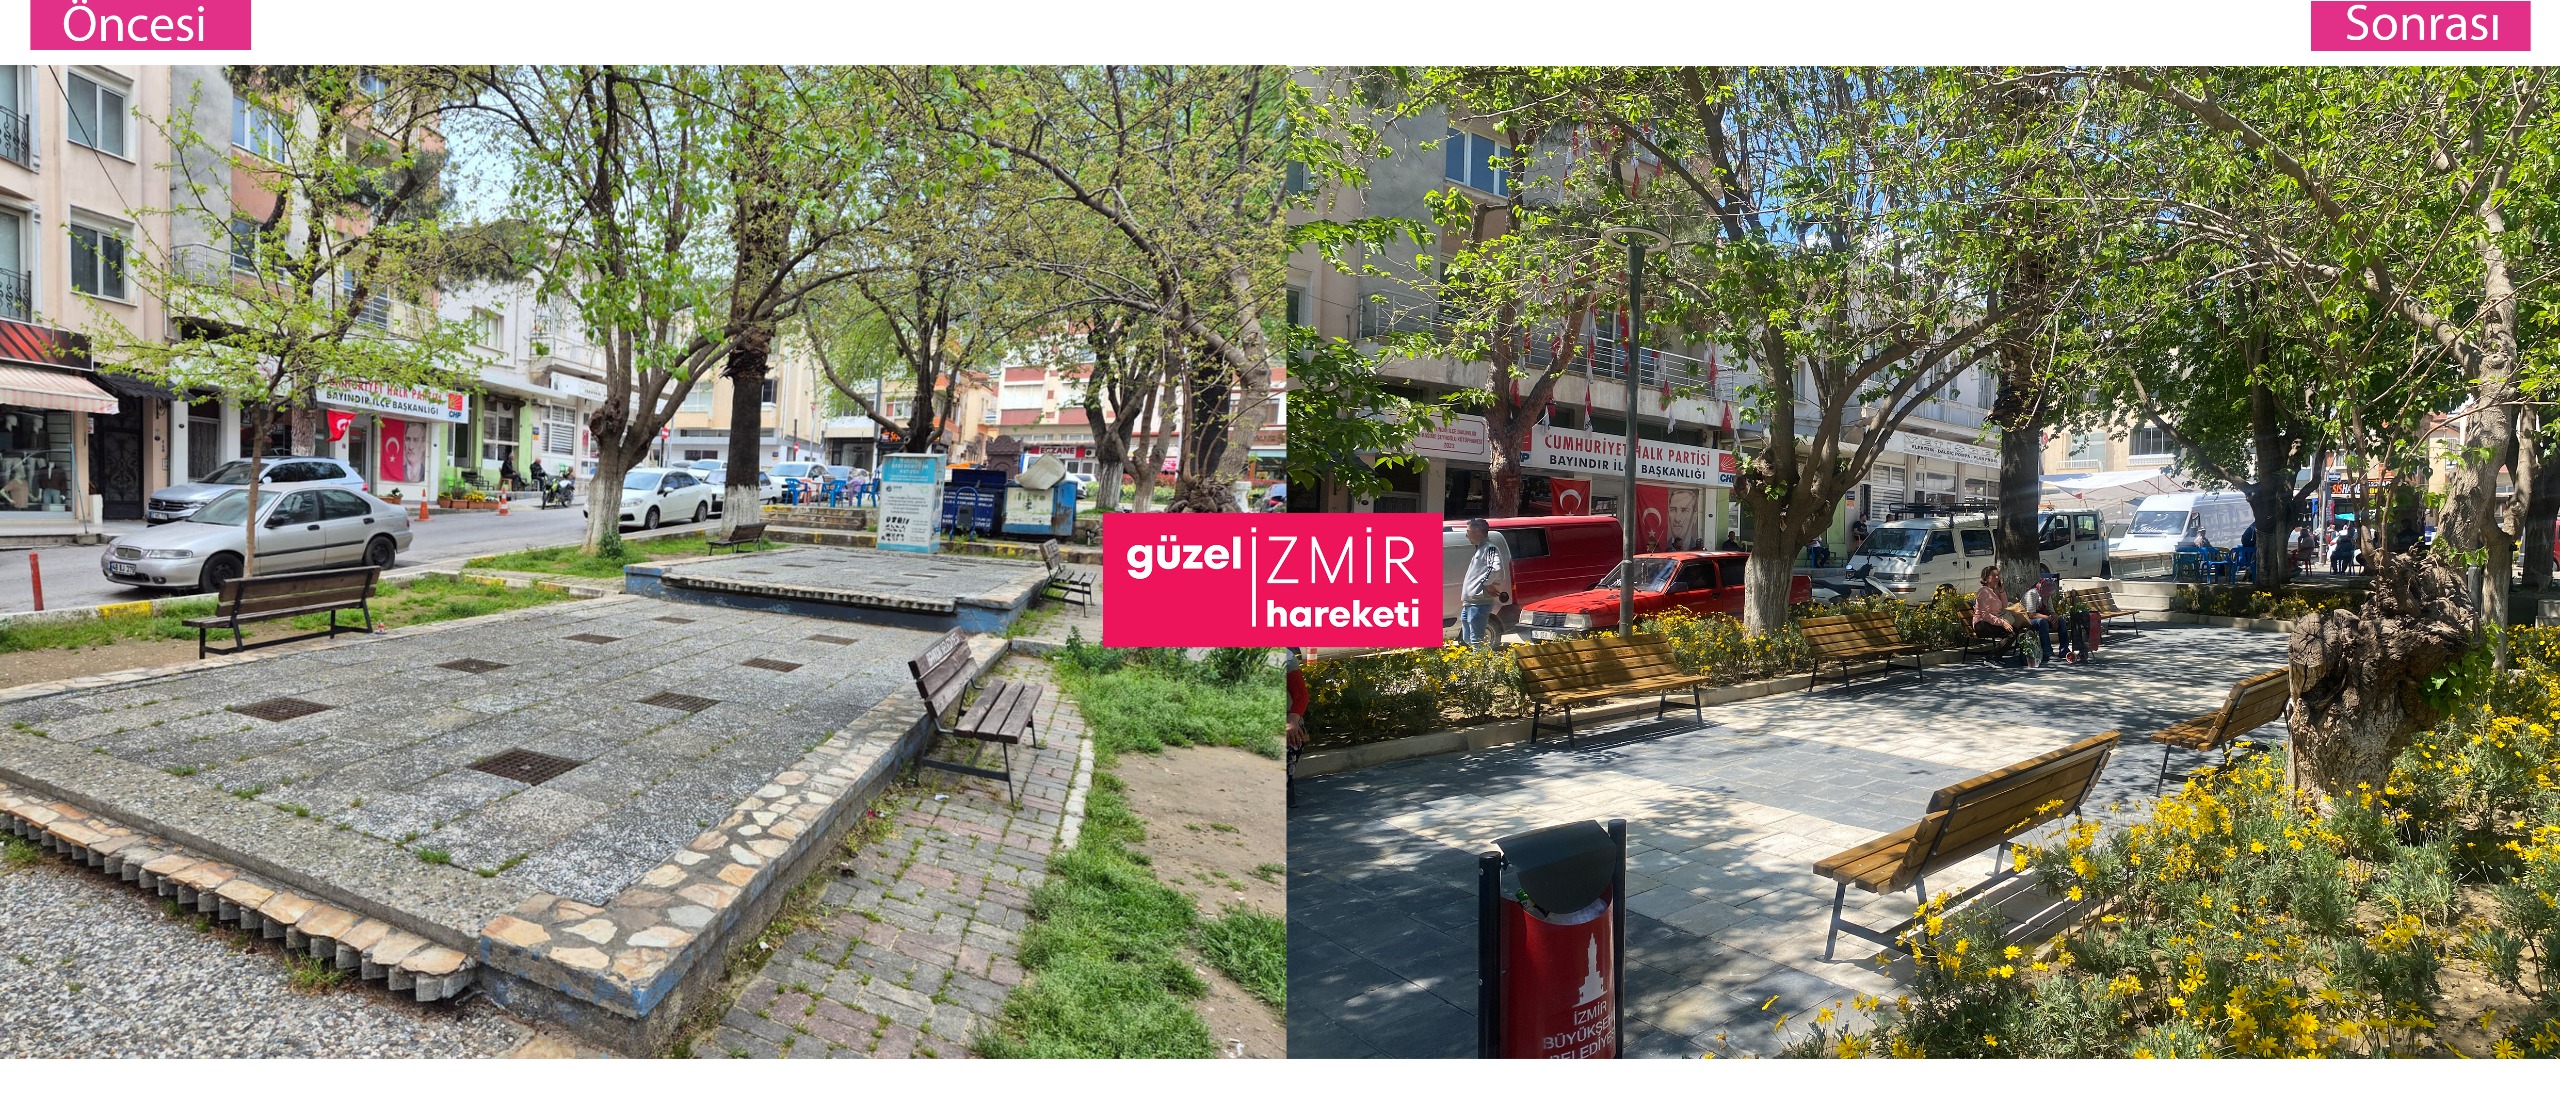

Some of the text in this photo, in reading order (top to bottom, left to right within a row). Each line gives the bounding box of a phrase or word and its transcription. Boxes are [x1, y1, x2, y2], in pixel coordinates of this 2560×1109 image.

[448, 410, 462, 419] CHP
[1545, 433, 1710, 467] CUMHURİYET HALK PARTİSİ
[1549, 454, 1609, 470] BAYINDIR
[1641, 464, 1706, 480] BAŞKANLIĞI
[1719, 473, 1734, 483] CH
[1573, 1000, 1607, 1026] İZMİR
